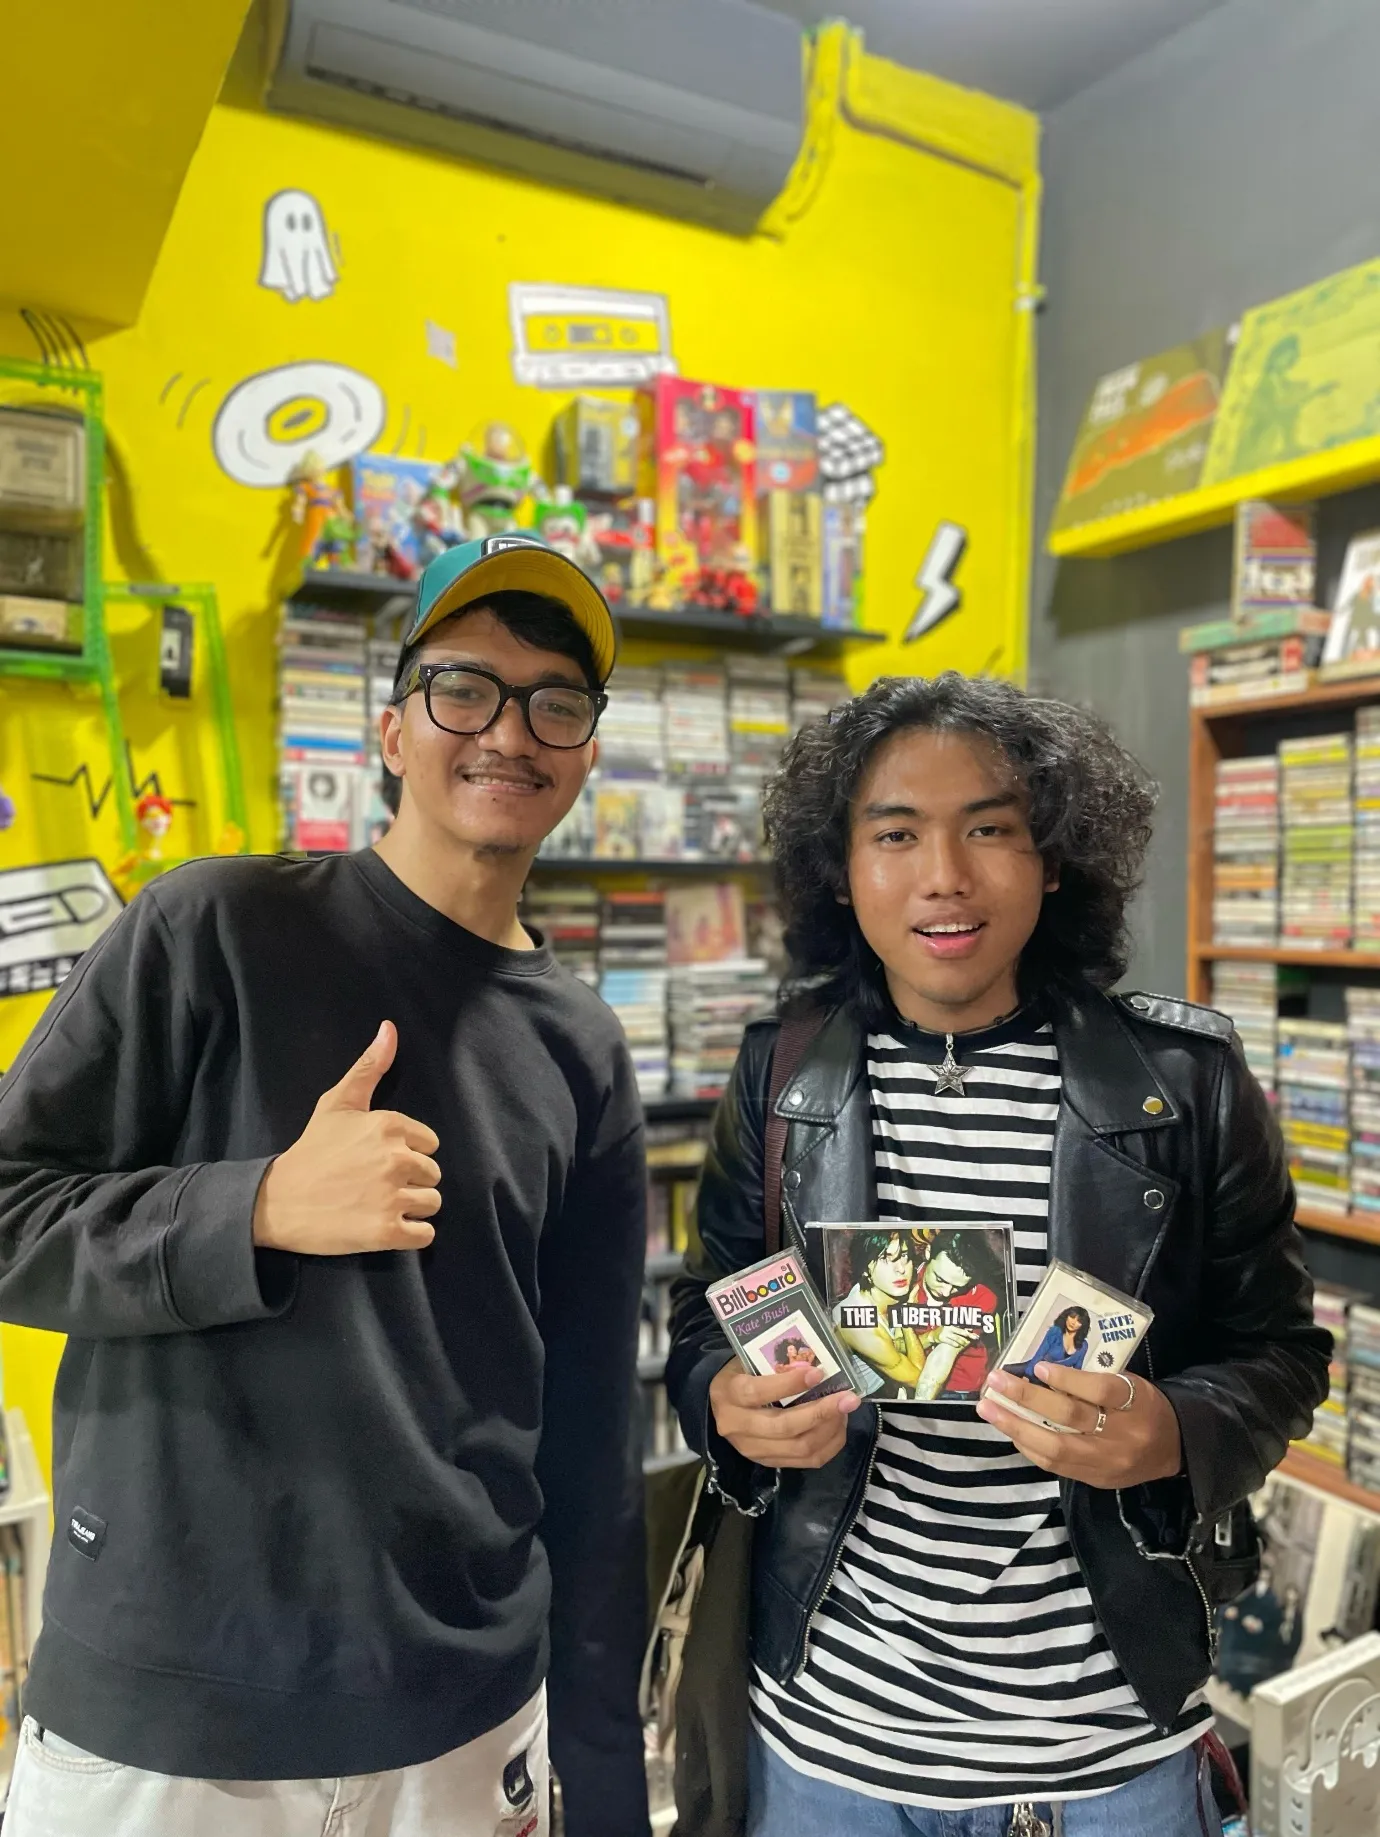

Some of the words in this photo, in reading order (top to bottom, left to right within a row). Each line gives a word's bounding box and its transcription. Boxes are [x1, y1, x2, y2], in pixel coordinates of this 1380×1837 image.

[716, 1263, 797, 1316] Billboard
[735, 1318, 761, 1337] Kate
[761, 1301, 790, 1324] Bush
[843, 1307, 876, 1326] THE
[891, 1306, 995, 1334] LIBERTINES
[1098, 1313, 1135, 1330] KATE
[1102, 1327, 1137, 1343] BUSH
